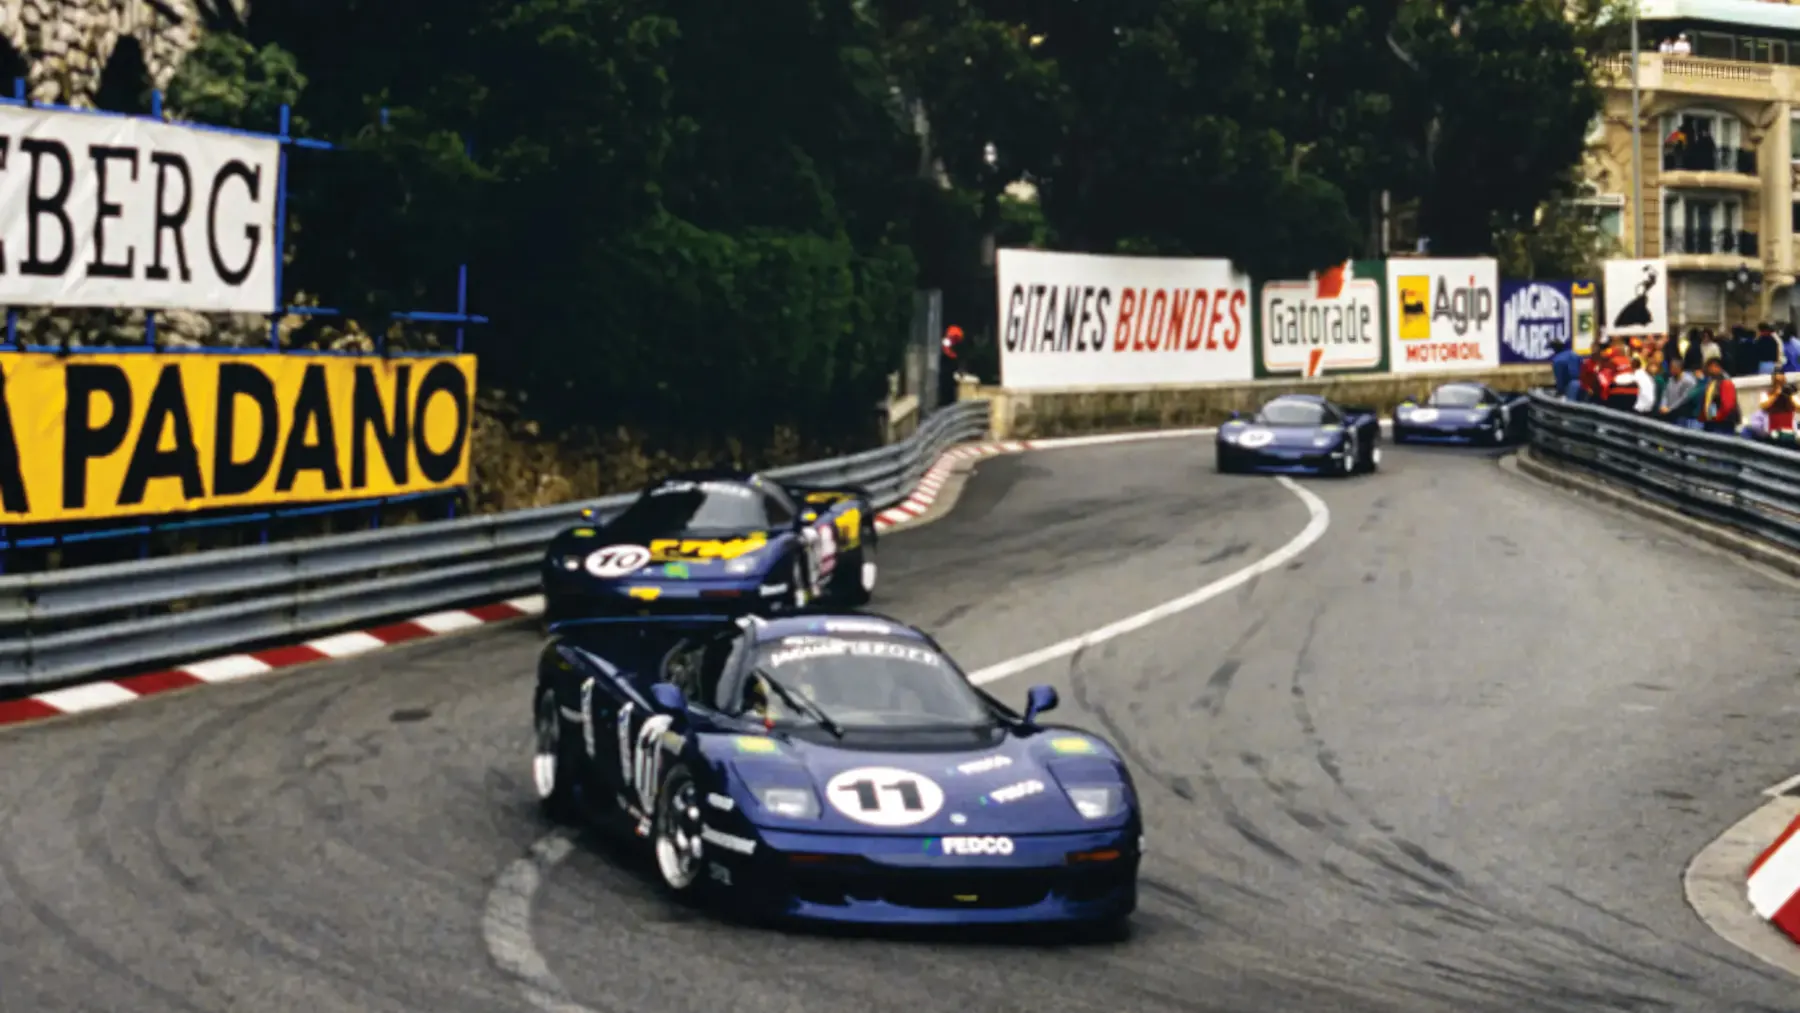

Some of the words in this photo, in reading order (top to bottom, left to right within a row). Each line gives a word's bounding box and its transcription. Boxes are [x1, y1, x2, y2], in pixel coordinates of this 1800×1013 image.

[0, 136, 262, 286] BERG
[1005, 284, 1111, 352] GITANES
[1113, 287, 1247, 352] BLONDES
[1270, 297, 1372, 345] Gatorade
[1432, 275, 1492, 336] Agip
[63, 361, 469, 509] PADANO
[595, 552, 641, 569] 10
[837, 779, 925, 812] 11
[941, 836, 1015, 856] FEDCO
